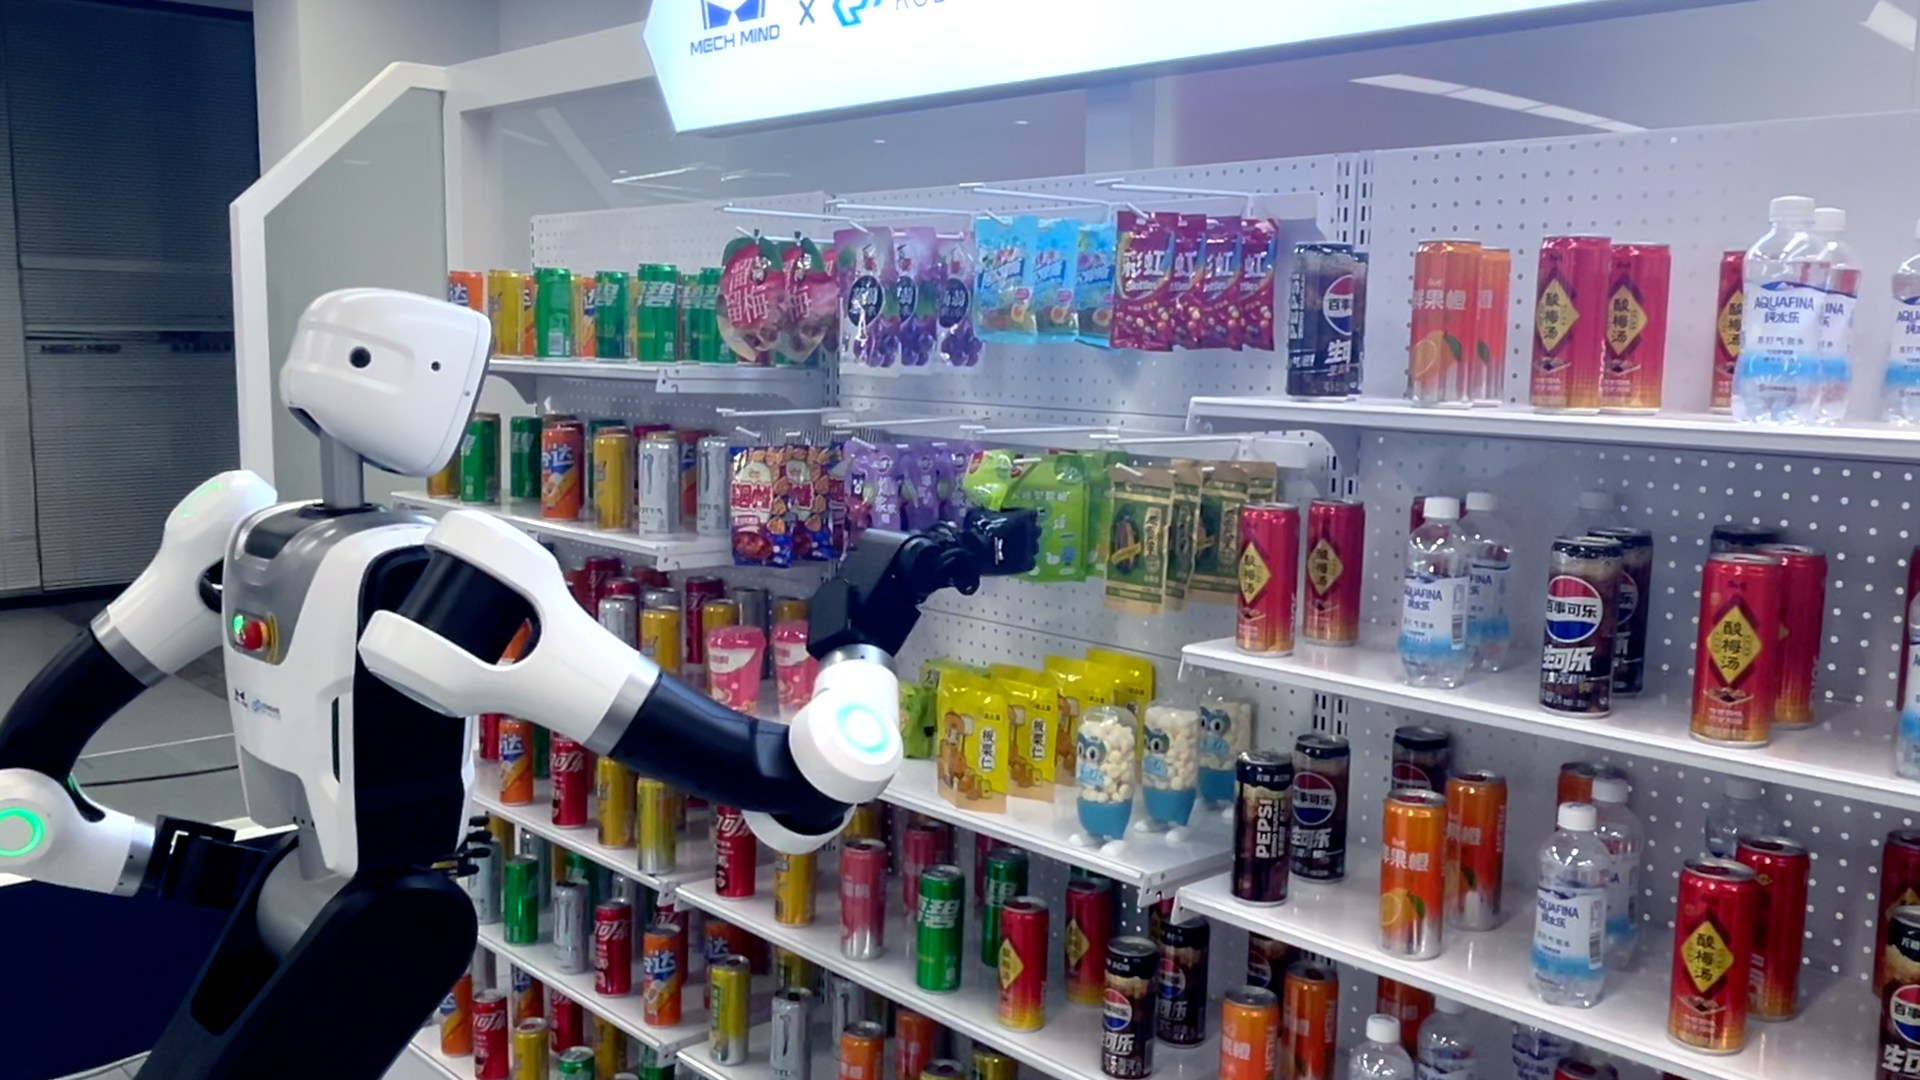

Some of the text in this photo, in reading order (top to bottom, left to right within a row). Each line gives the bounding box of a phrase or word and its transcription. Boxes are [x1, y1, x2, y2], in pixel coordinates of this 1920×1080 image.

[690, 24, 780, 56] MECH MIND
[1122, 250, 1165, 278] 彩虹
[1543, 292, 1560, 341] 酸梅汤
[1754, 296, 1815, 311] AQUAFINA
[1764, 311, 1800, 324] 纯水乐
[1611, 299, 1629, 344] 酸梅汤
[1404, 587, 1443, 602] QUAFINA
[1721, 620, 1743, 671] 酸梅汤
[1255, 799, 1273, 859] PEPSI
[1539, 899, 1580, 919] QUAFINA
[1696, 932, 1714, 982] 酸梅汤
